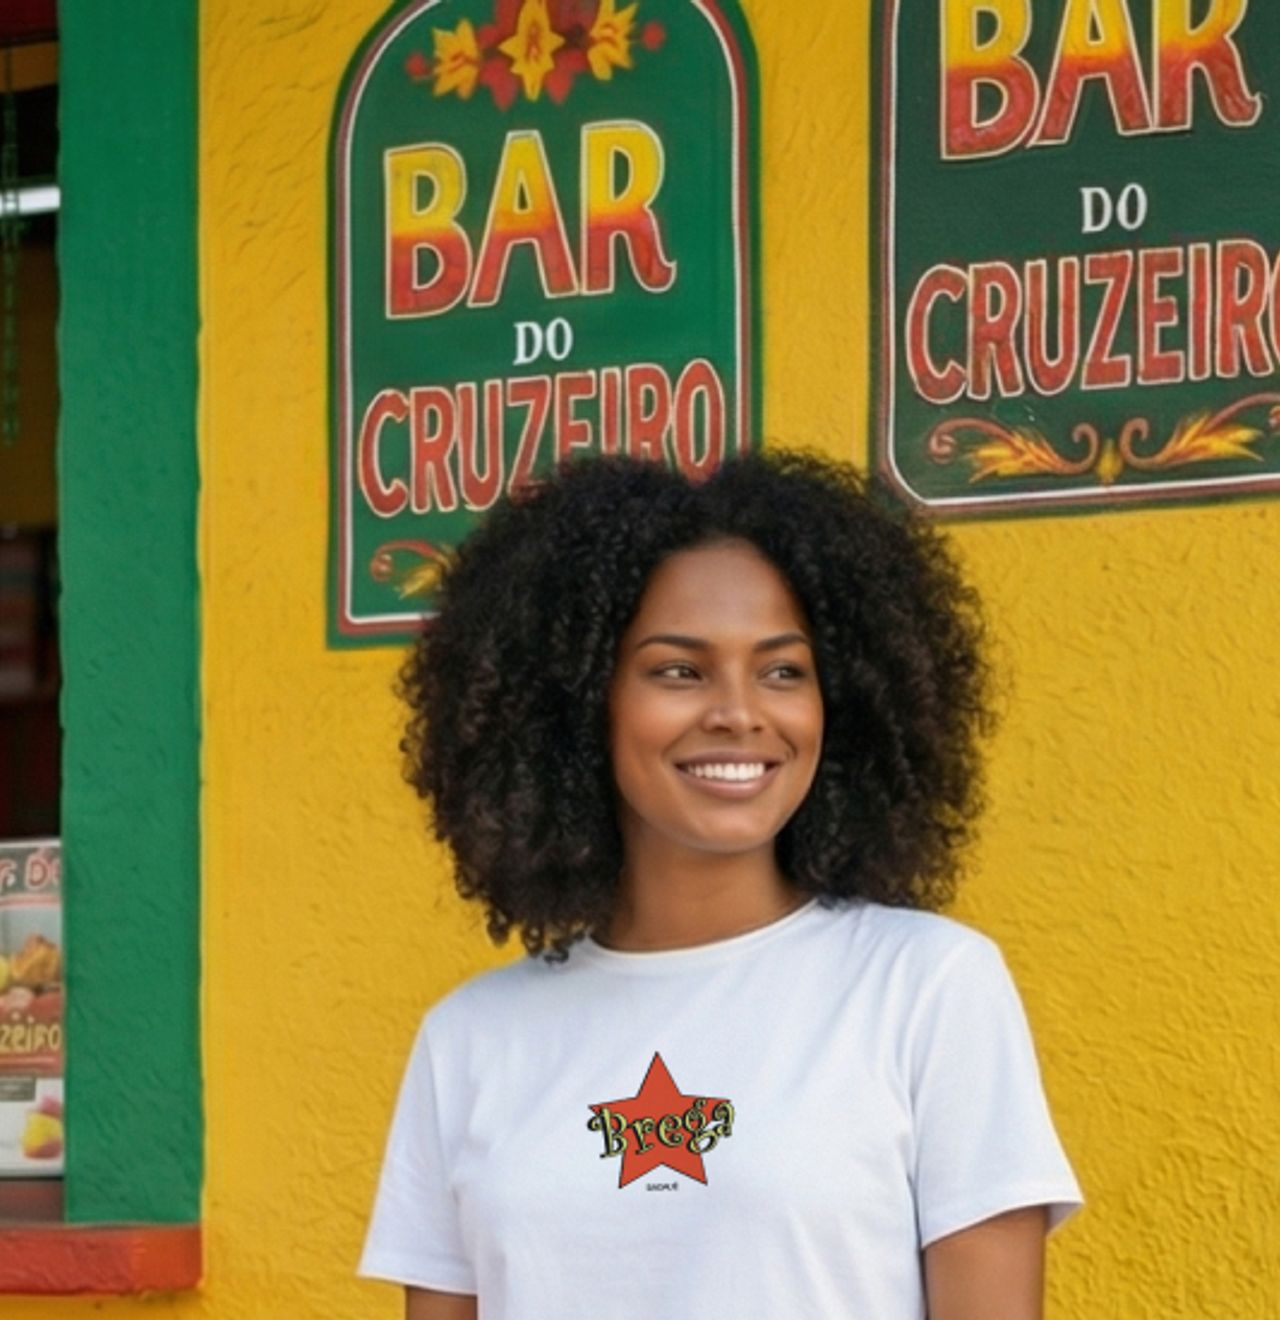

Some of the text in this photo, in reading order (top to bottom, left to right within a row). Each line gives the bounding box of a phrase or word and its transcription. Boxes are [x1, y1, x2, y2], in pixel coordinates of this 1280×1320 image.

[940, 0, 1263, 161] BAR
[385, 120, 677, 319] BAR
[1080, 183, 1148, 233] DO
[514, 318, 573, 365] DO
[587, 1097, 735, 1159] Brega
